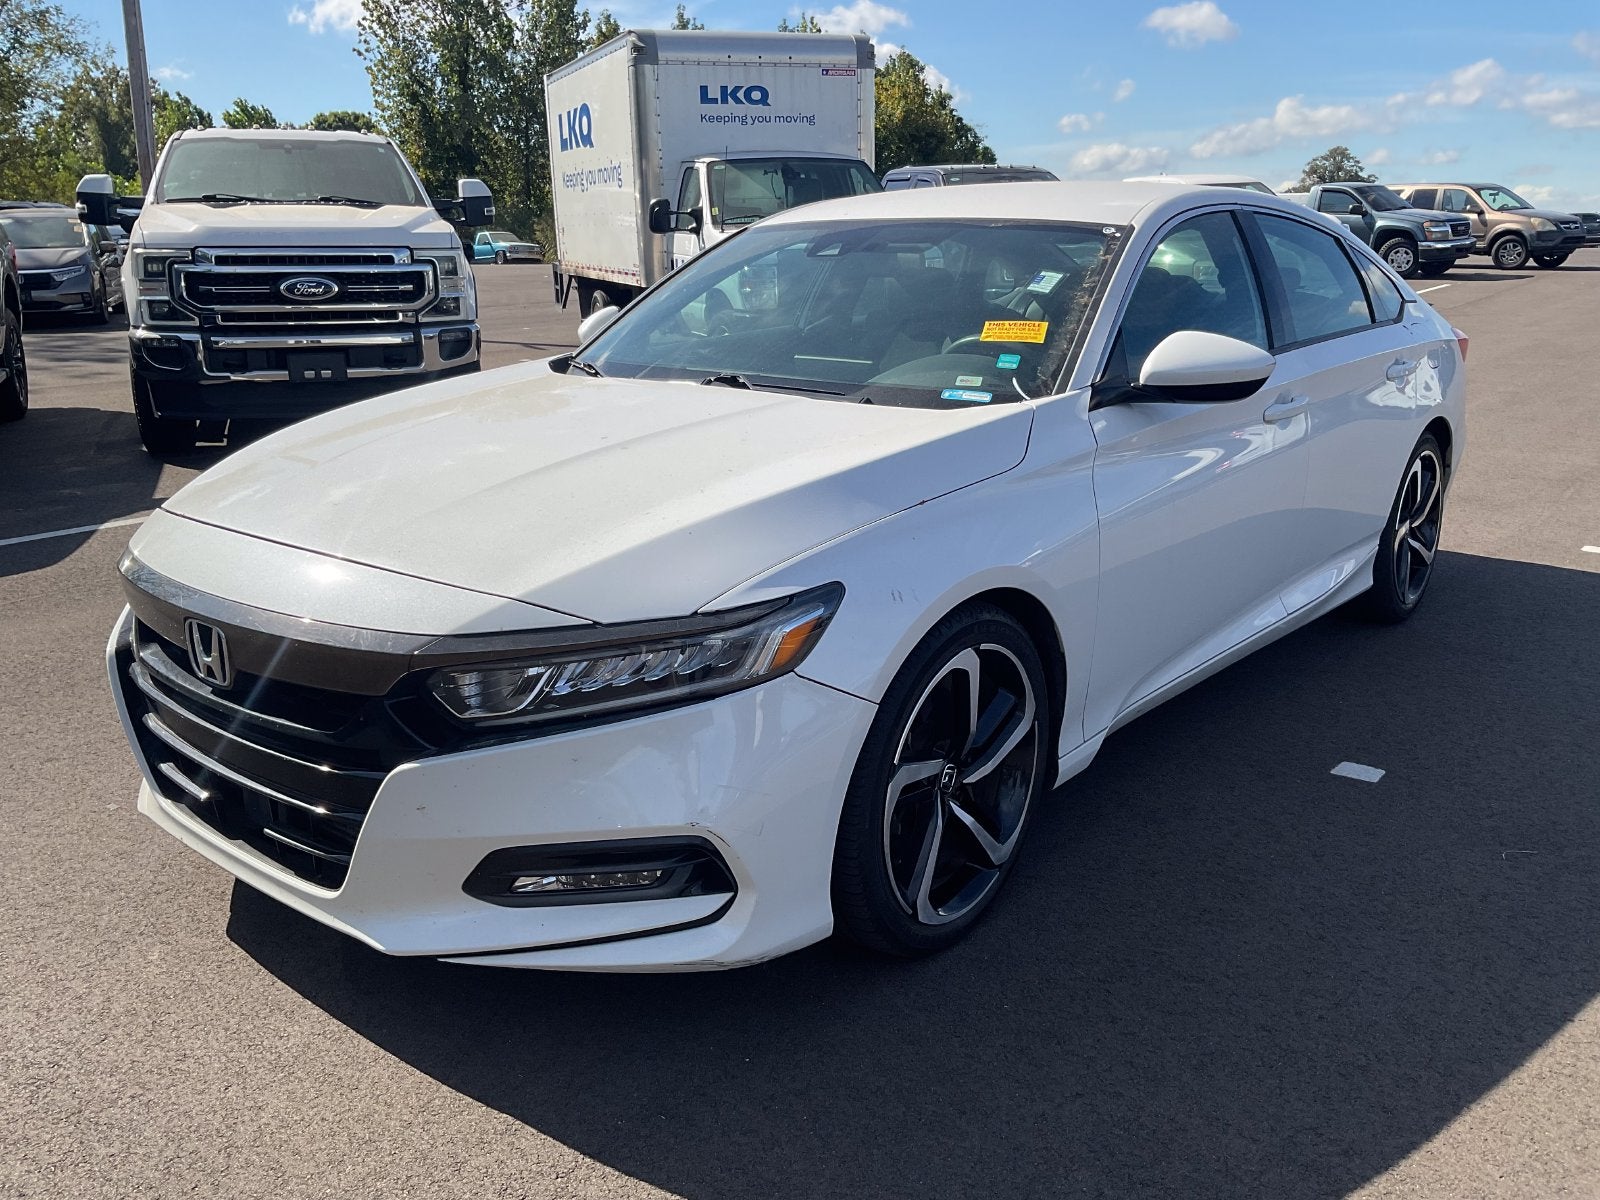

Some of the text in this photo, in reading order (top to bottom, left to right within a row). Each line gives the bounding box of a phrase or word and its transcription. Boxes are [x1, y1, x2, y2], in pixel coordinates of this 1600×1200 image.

[700, 85, 772, 107] LKQ
[558, 102, 595, 153] LKQ
[700, 112, 816, 126] Keeping you moving
[562, 160, 623, 193] Keeping you moving
[294, 282, 325, 295] Ford
